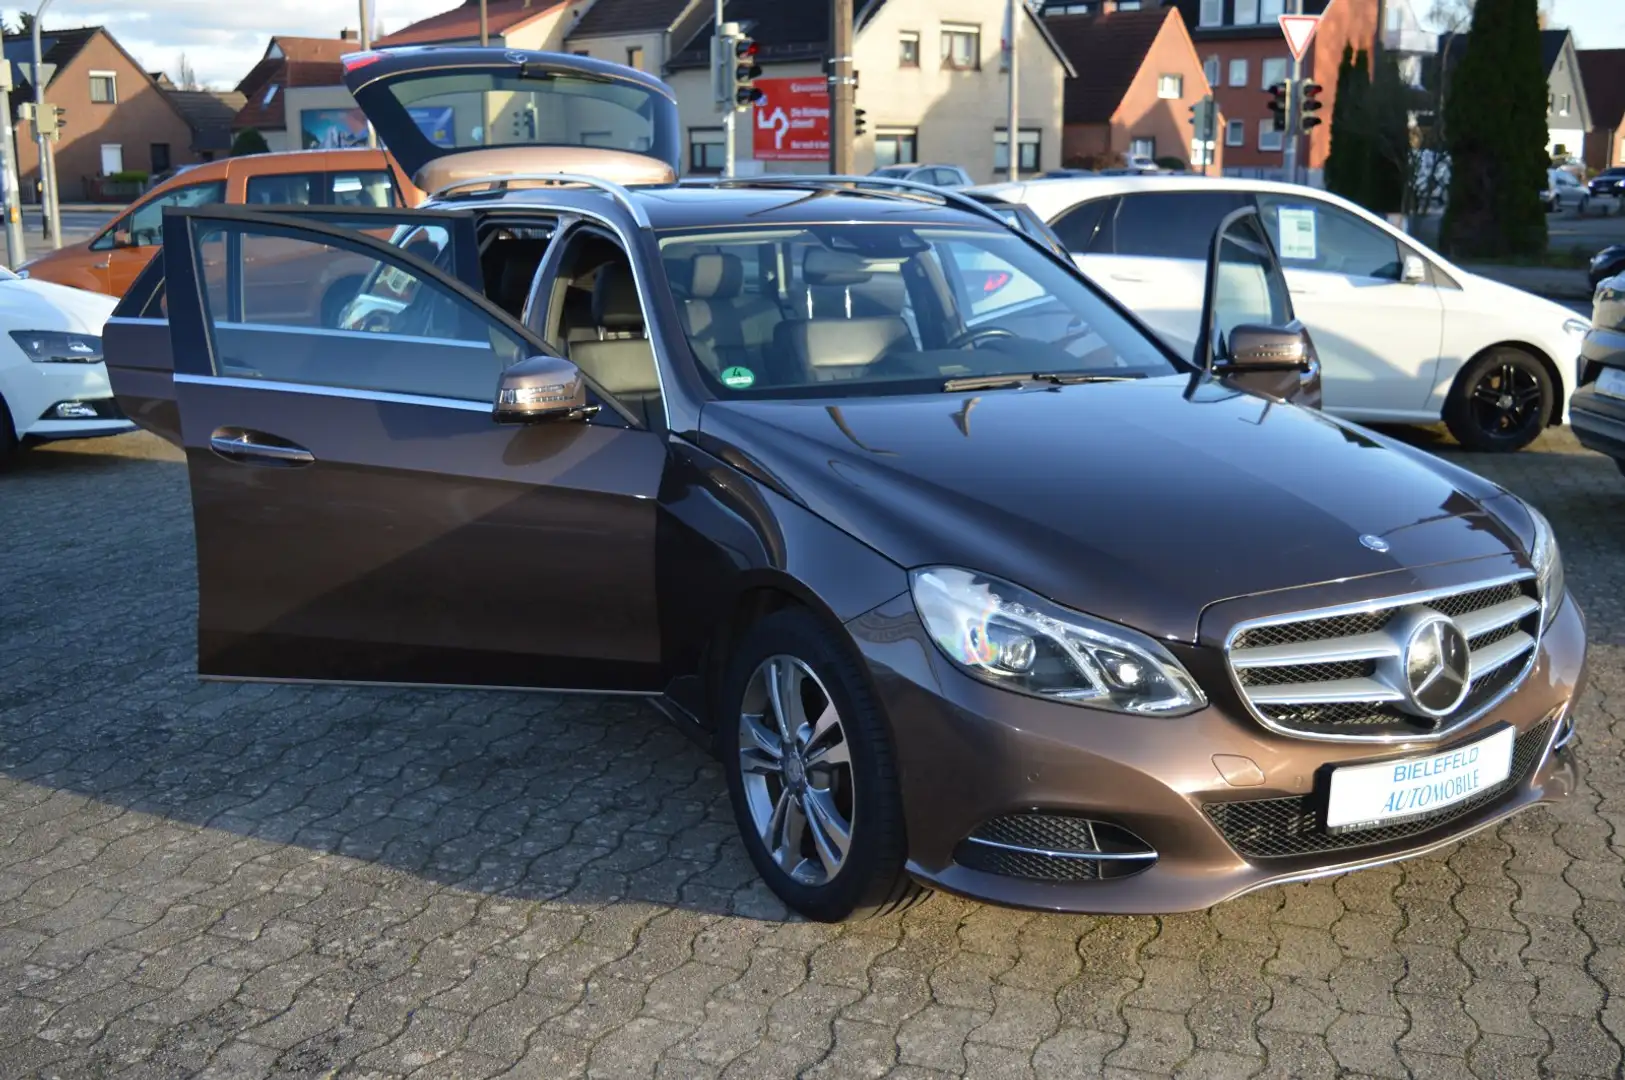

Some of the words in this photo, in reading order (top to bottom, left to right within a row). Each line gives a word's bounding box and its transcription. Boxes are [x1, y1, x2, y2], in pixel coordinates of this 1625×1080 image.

[732, 367, 742, 377] 4
[1393, 746, 1479, 783] BIELEFELD
[1379, 768, 1480, 814] AUTOMOBILE
